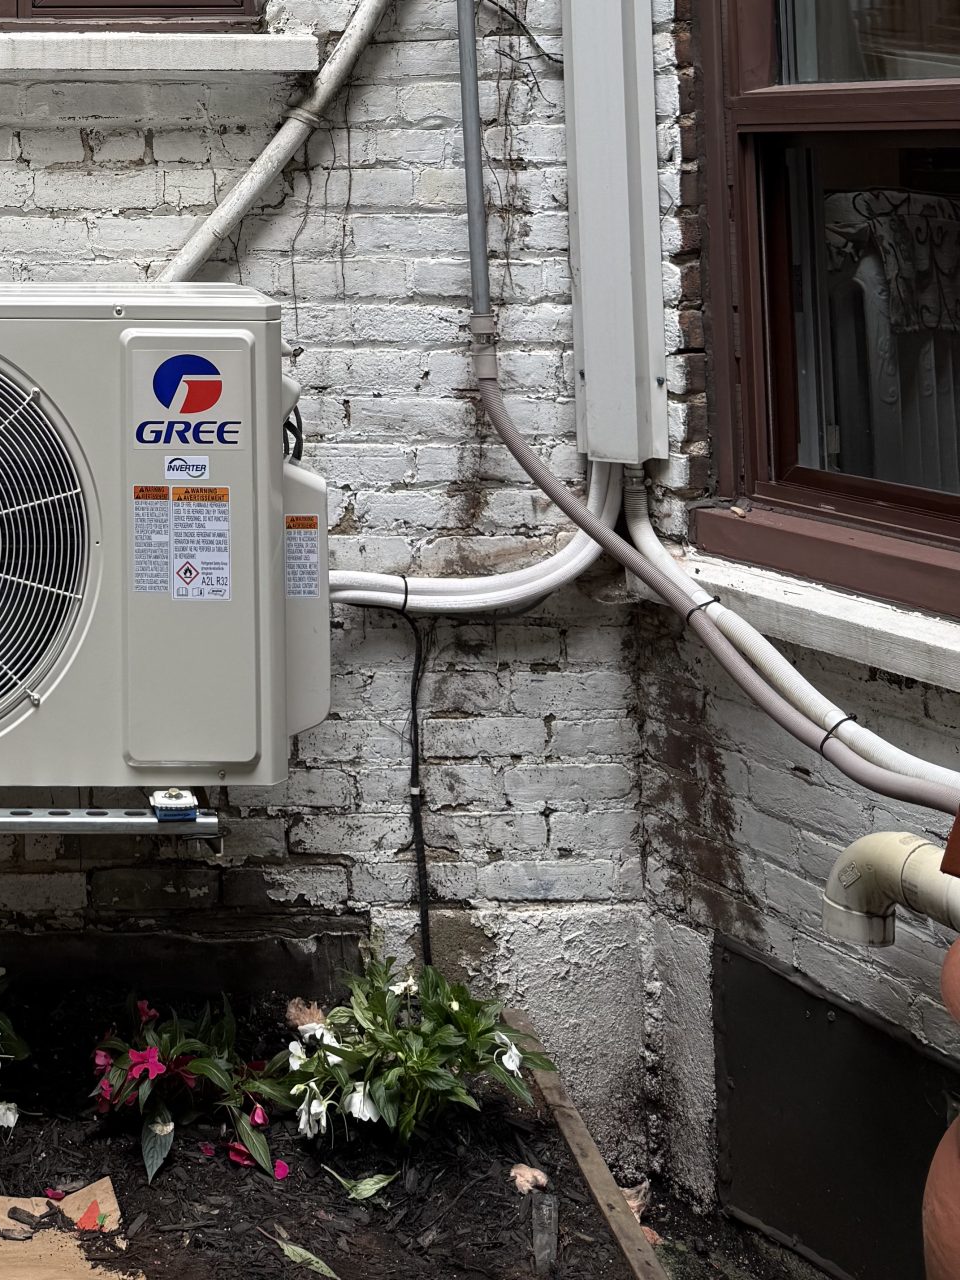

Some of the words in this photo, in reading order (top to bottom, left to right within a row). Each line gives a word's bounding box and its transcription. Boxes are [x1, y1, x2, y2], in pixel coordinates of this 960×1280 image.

[135, 421, 241, 444] GREE
[167, 464, 207, 472] INVERTER
[202, 577, 214, 585] A2L
[217, 577, 228, 585] R32
